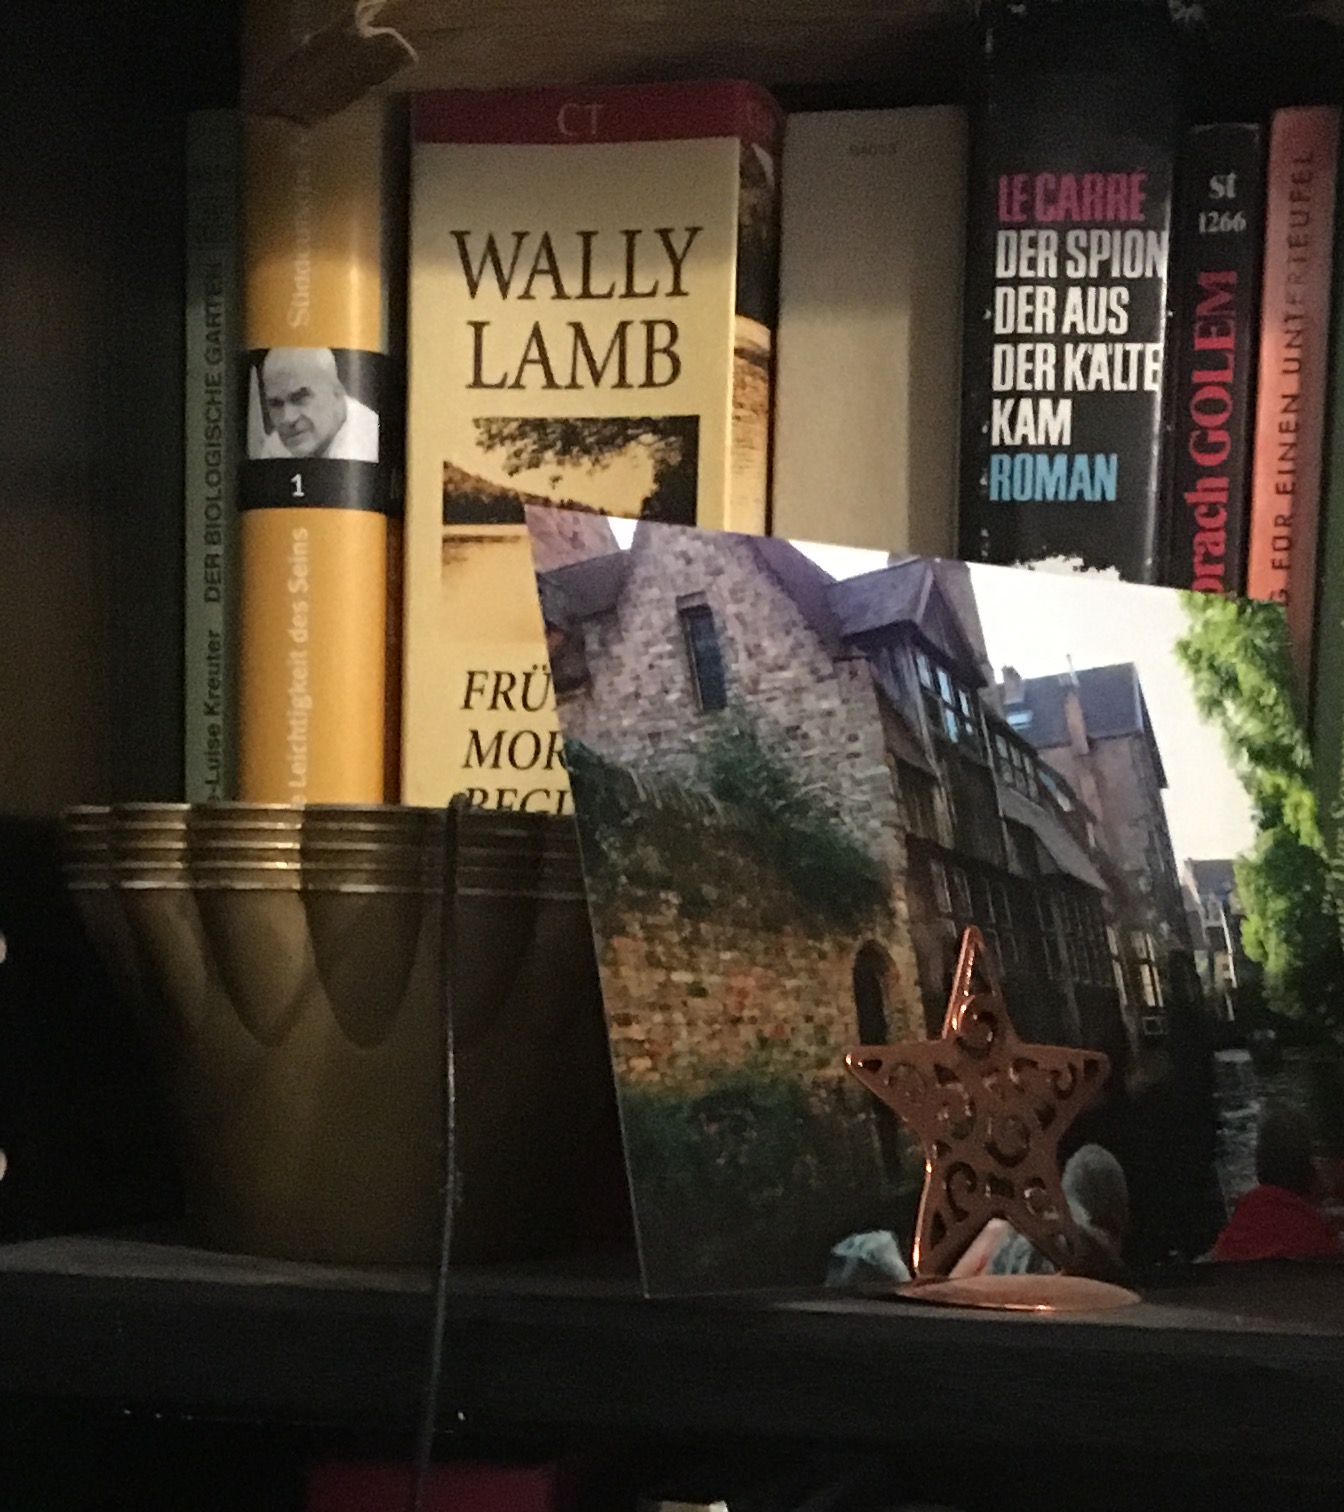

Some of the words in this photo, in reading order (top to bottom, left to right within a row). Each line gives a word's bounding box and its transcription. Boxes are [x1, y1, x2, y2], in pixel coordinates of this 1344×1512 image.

[556, 102, 604, 138] CT
[998, 173, 1027, 223] LE
[1034, 166, 1147, 223] CARRÉ
[1208, 172, 1237, 199] st
[1198, 210, 1247, 234] 1266
[449, 226, 703, 300] WALLY
[995, 229, 1057, 279] DER
[1065, 228, 1167, 279] SPION
[1280, 151, 1313, 375] UNTERTEUFEL
[994, 285, 1056, 335] DER
[1060, 285, 1130, 335] AUS
[464, 318, 682, 390] LAMB
[992, 342, 1056, 392] DER
[1063, 341, 1163, 392] KÄLTE
[1188, 268, 1238, 467] GOLEM
[990, 398, 1073, 446] KAM
[1272, 392, 1299, 496] EINEN
[203, 372, 223, 546] BIOLOGISCHE
[291, 473, 305, 498] 1
[989, 452, 1118, 502] ROMAN
[288, 527, 308, 593] Seins
[1269, 513, 1293, 571] FÜR
[204, 552, 223, 605] DER
[288, 600, 308, 643] des
[204, 629, 223, 717] Kreuter
[288, 650, 313, 788] Leichtigkeit
